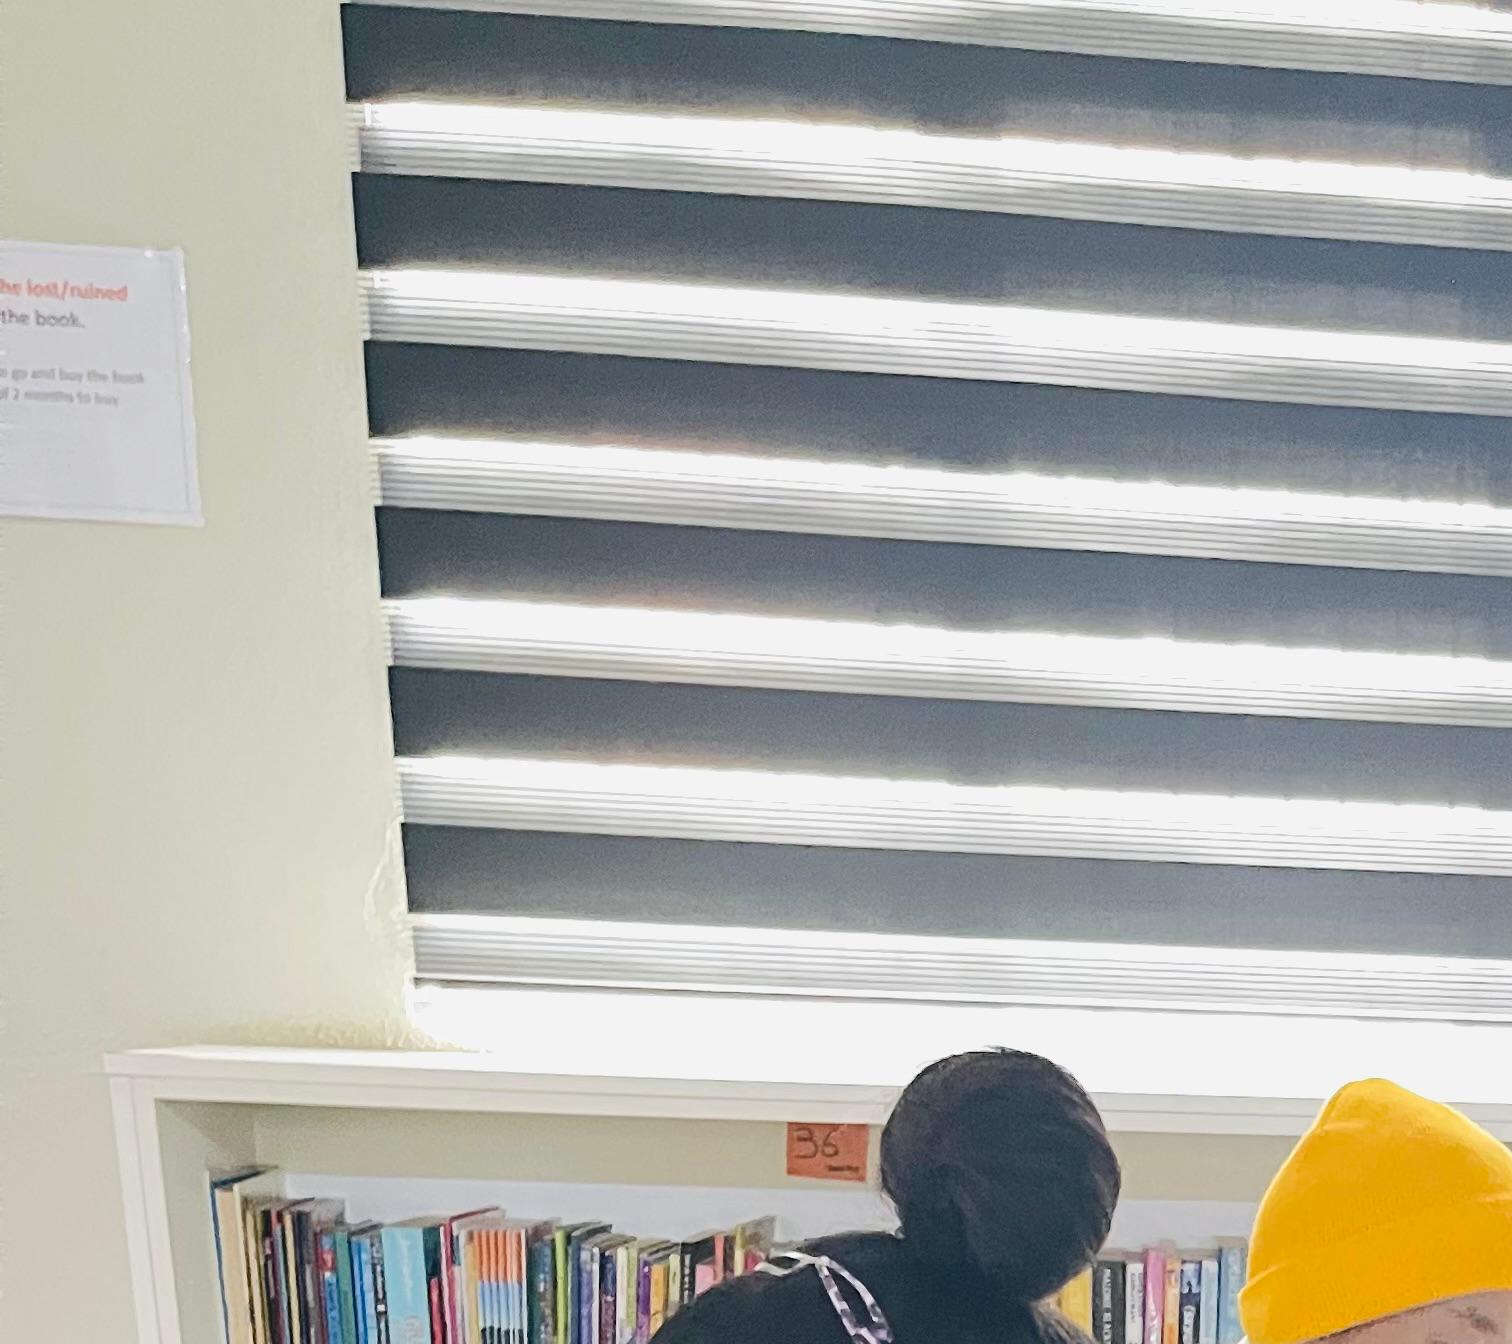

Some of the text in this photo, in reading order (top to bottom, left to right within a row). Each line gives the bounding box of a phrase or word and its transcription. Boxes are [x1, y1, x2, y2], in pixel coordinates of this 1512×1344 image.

[27, 278, 128, 301] lost/ruined
[35, 310, 86, 328] book.
[794, 1126, 839, 1159] 36
